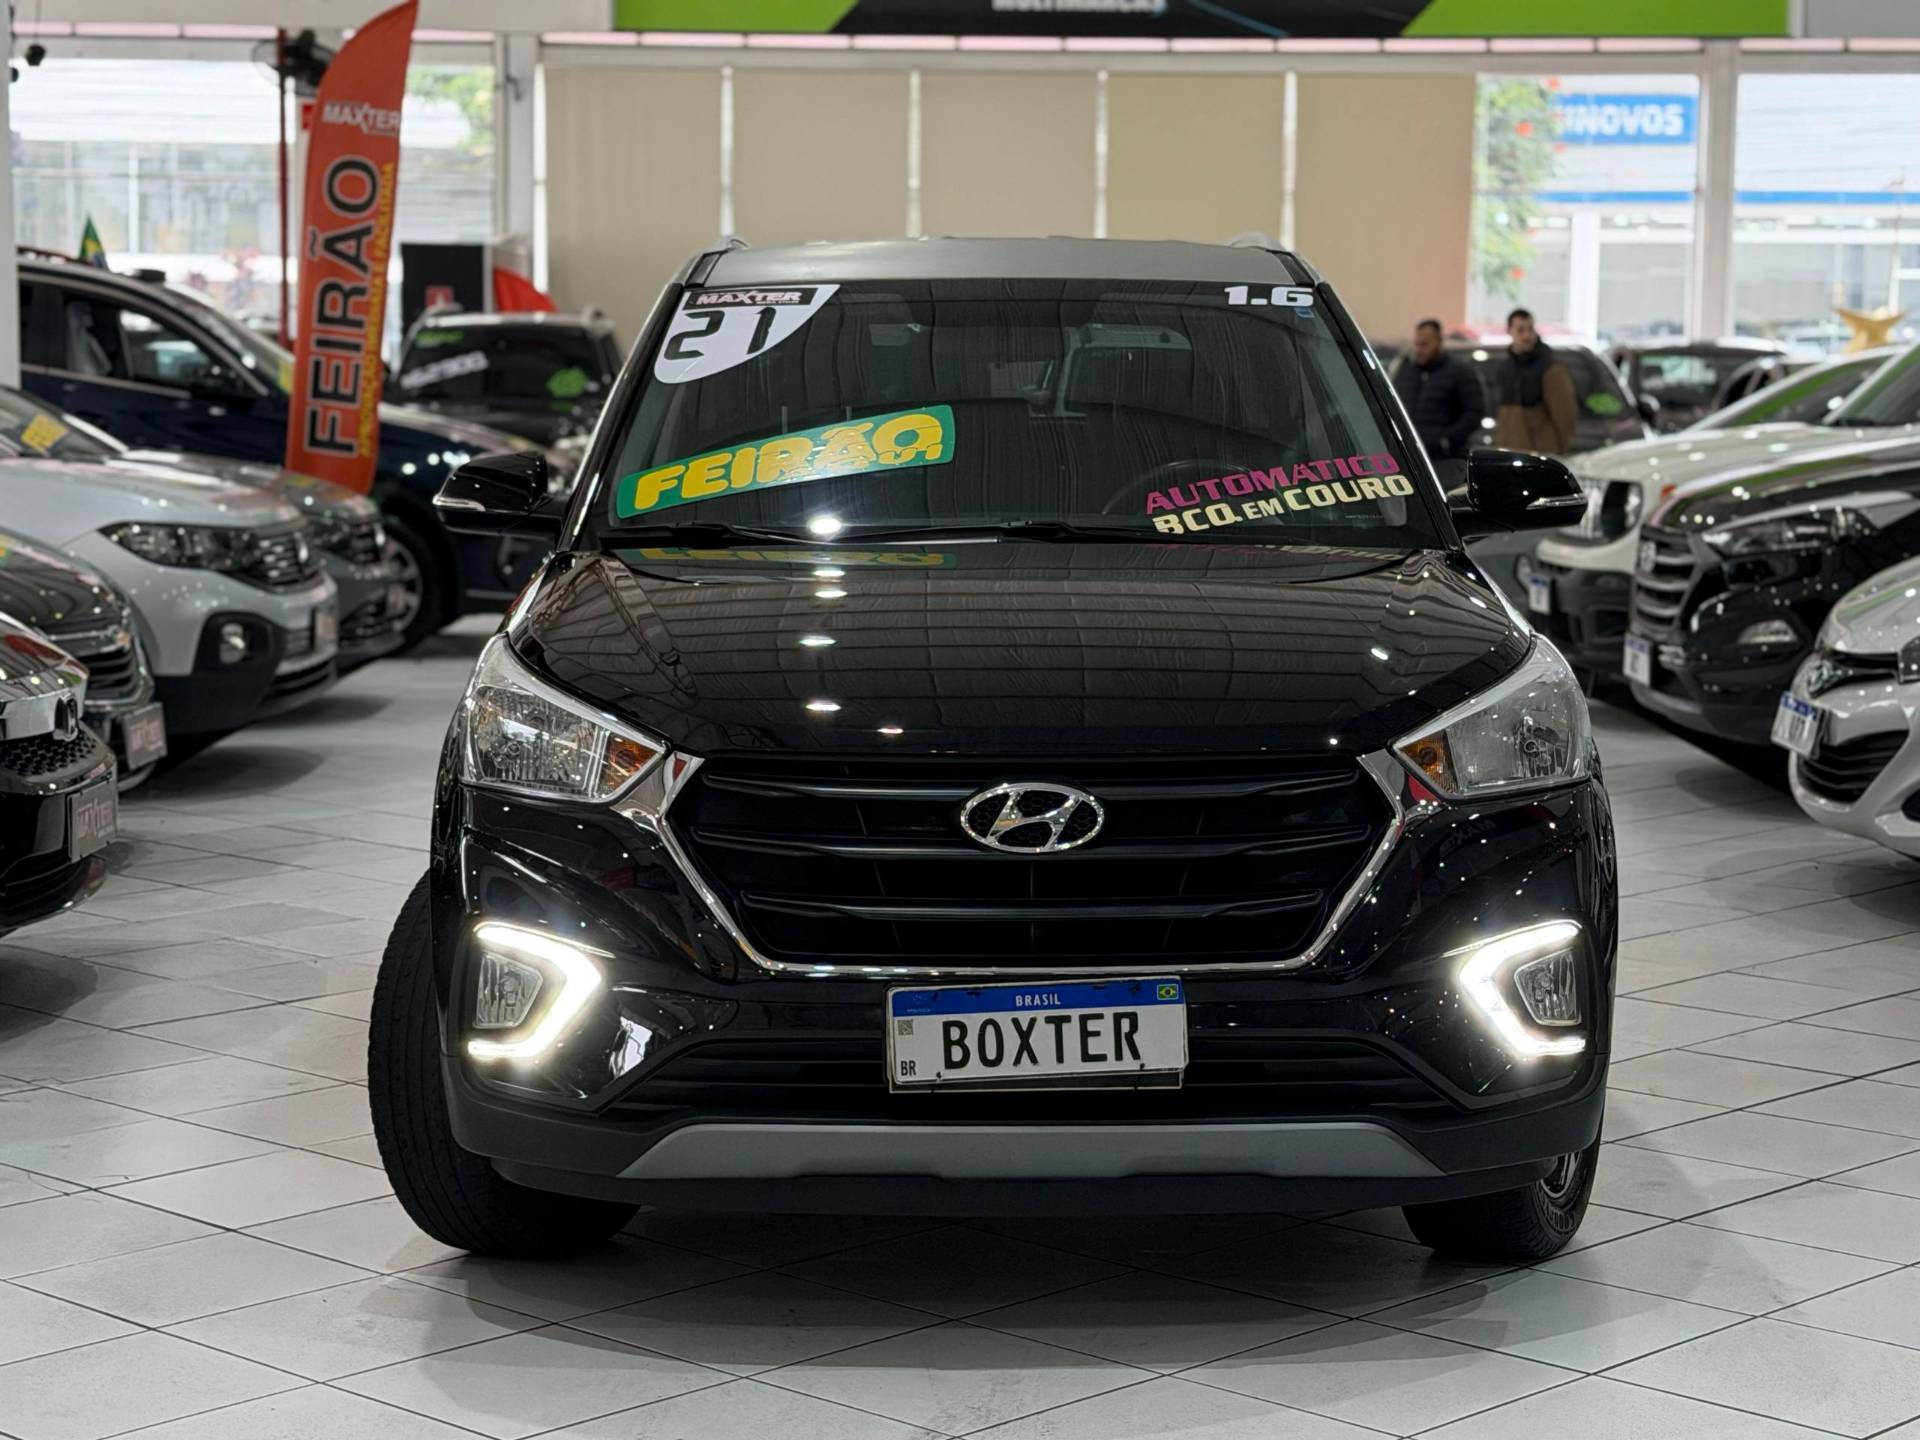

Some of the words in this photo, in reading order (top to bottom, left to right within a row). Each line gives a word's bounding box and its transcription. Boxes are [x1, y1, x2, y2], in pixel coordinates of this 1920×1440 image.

[322, 102, 401, 135] MAXTER
[308, 155, 379, 458] FEIRÃO
[696, 290, 802, 305] MAXTER
[1224, 286, 1313, 306] 1.6
[663, 306, 777, 361] 21
[634, 414, 943, 510] FEIRÃO
[1241, 498, 1285, 520] EM
[1283, 474, 1415, 511] COURO
[1015, 993, 1061, 1007] BRASIL
[942, 1011, 1141, 1070] BOXTER
[901, 1060, 916, 1077] BR
